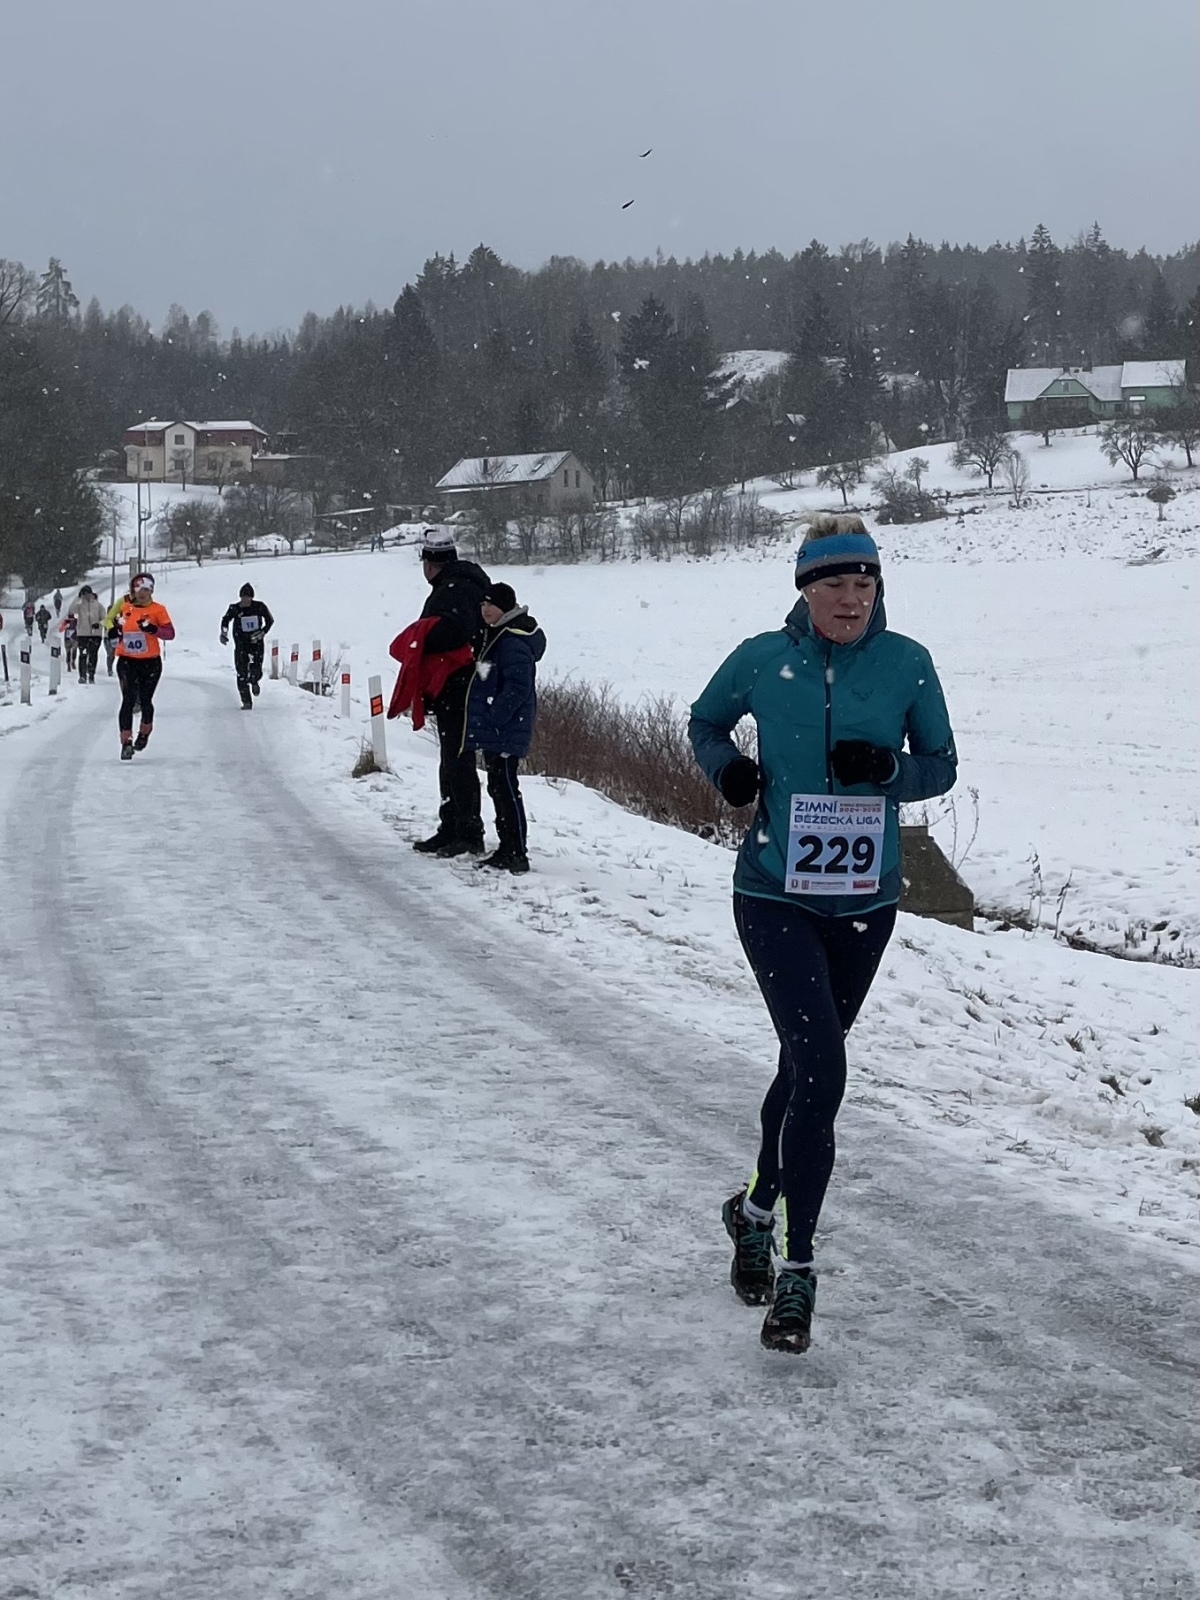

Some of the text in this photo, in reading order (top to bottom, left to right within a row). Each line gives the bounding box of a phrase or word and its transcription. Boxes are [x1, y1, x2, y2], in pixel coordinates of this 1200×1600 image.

[128, 640, 142, 649] 40
[795, 800, 838, 813] ZIMNÍ
[795, 814, 881, 825] BĚŽECKÁ LIGA
[795, 835, 875, 874] 229
